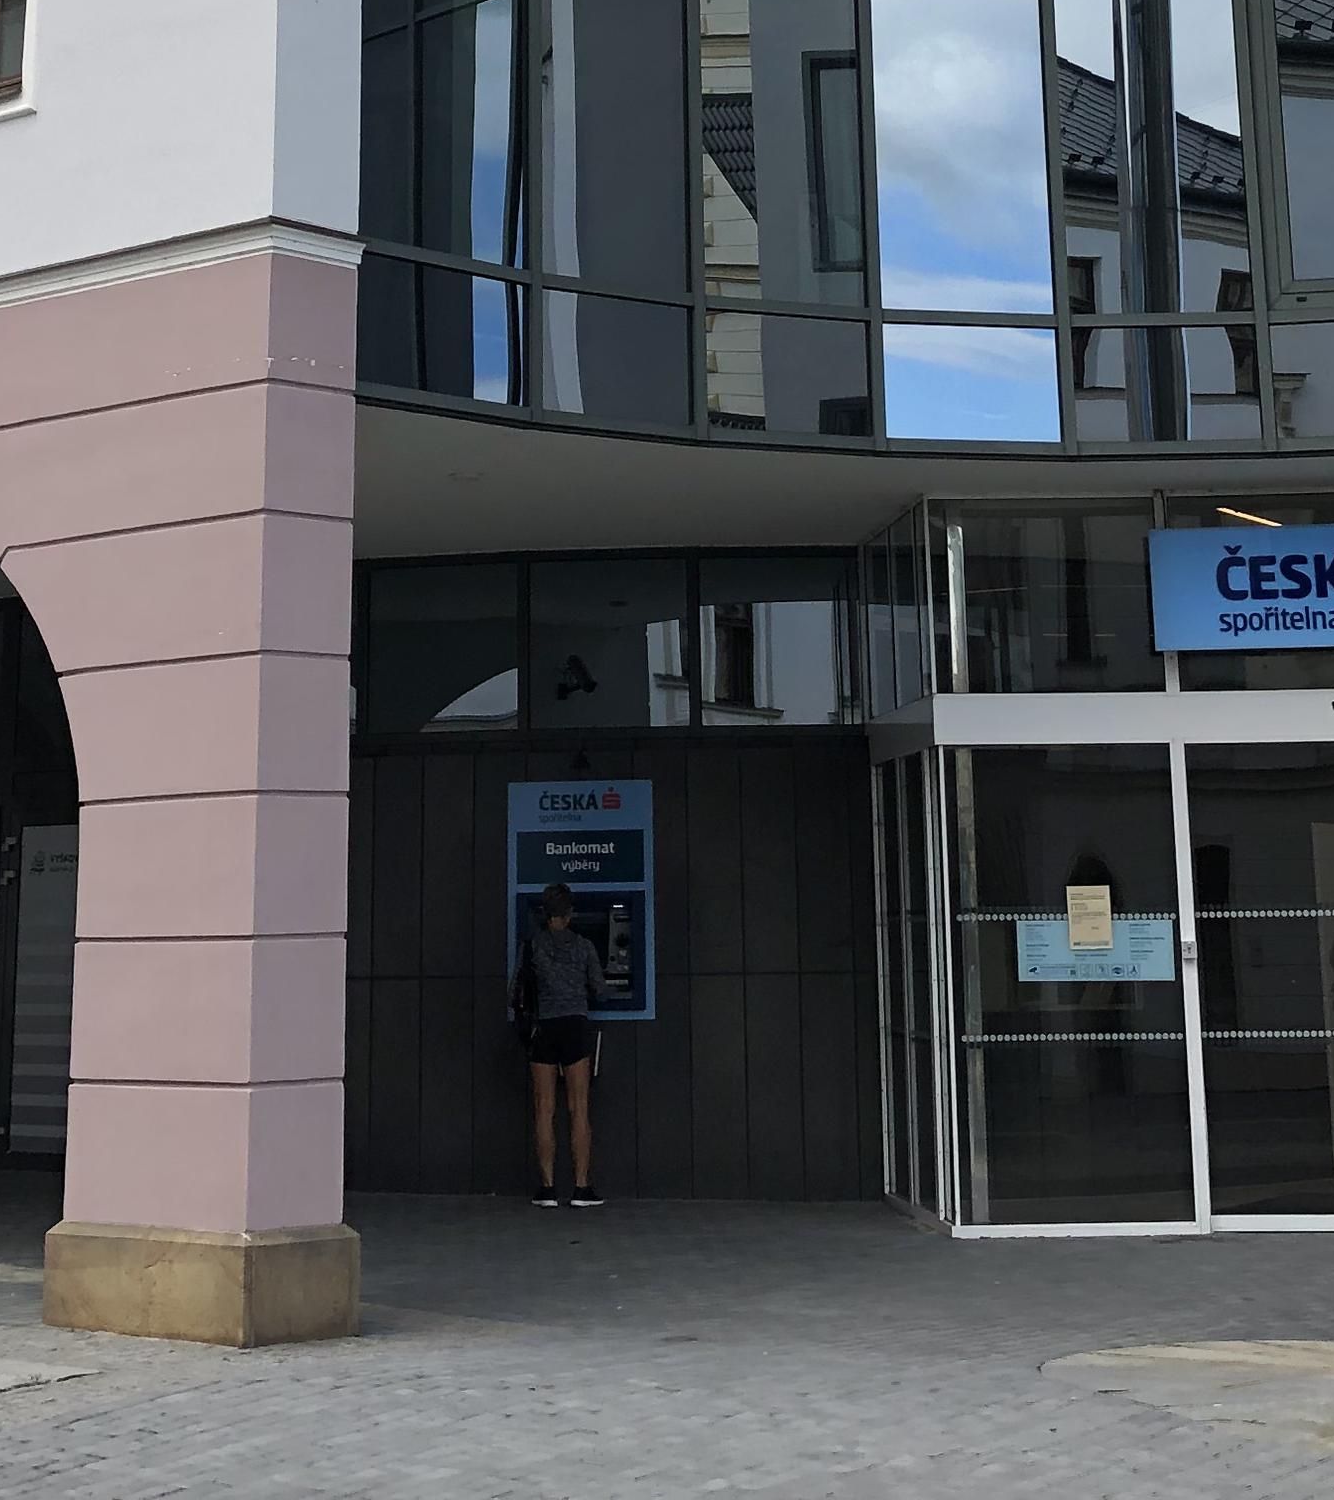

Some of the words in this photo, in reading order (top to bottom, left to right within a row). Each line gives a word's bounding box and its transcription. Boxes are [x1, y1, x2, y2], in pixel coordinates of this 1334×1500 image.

[539, 789, 598, 811] ČESKÁ
[546, 842, 615, 855] Bankomat
[561, 860, 600, 873] výběry
